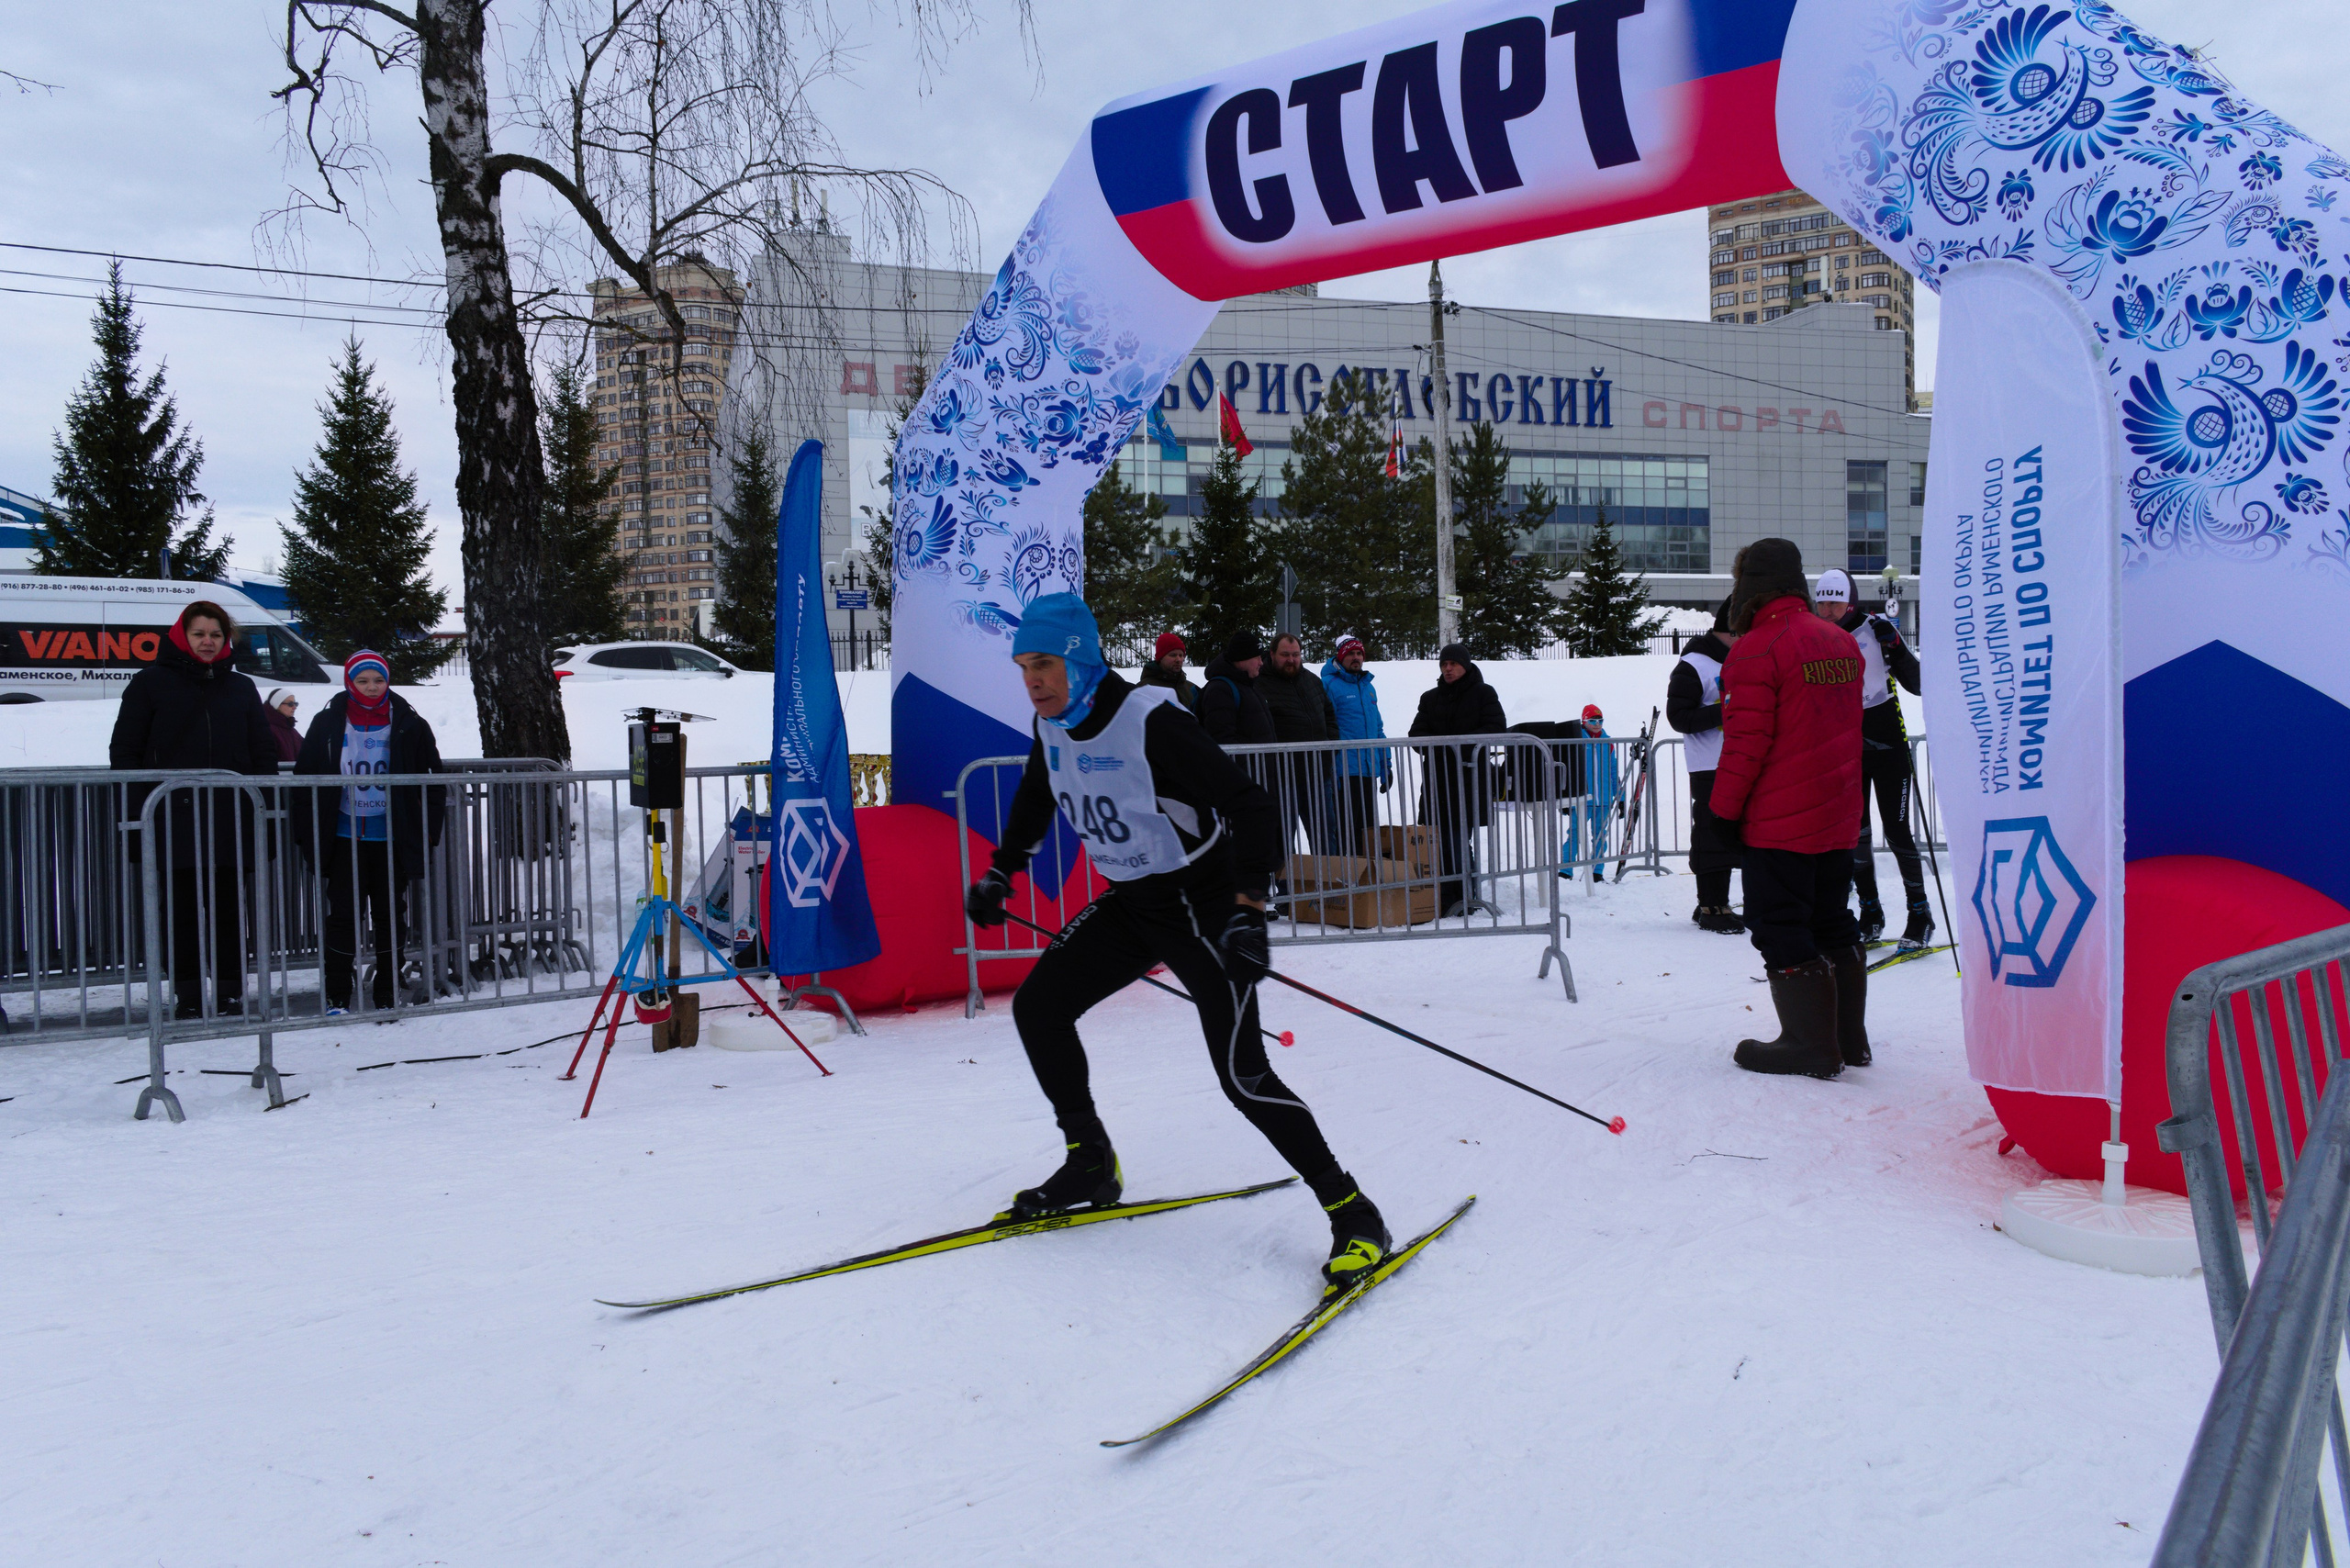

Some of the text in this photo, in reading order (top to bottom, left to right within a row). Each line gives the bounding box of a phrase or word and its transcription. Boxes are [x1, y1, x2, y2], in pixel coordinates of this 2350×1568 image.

[1204, 0, 1645, 243] СТАРТ
[1642, 401, 1846, 434] СПОРТА
[18, 630, 161, 661] VIANO
[1802, 657, 1860, 686] RUSSIA
[780, 736, 805, 783] КОМ
[1059, 791, 1131, 845] 248
[1059, 904, 1099, 942] CRAFT
[992, 1216, 1072, 1240] FISCHER
